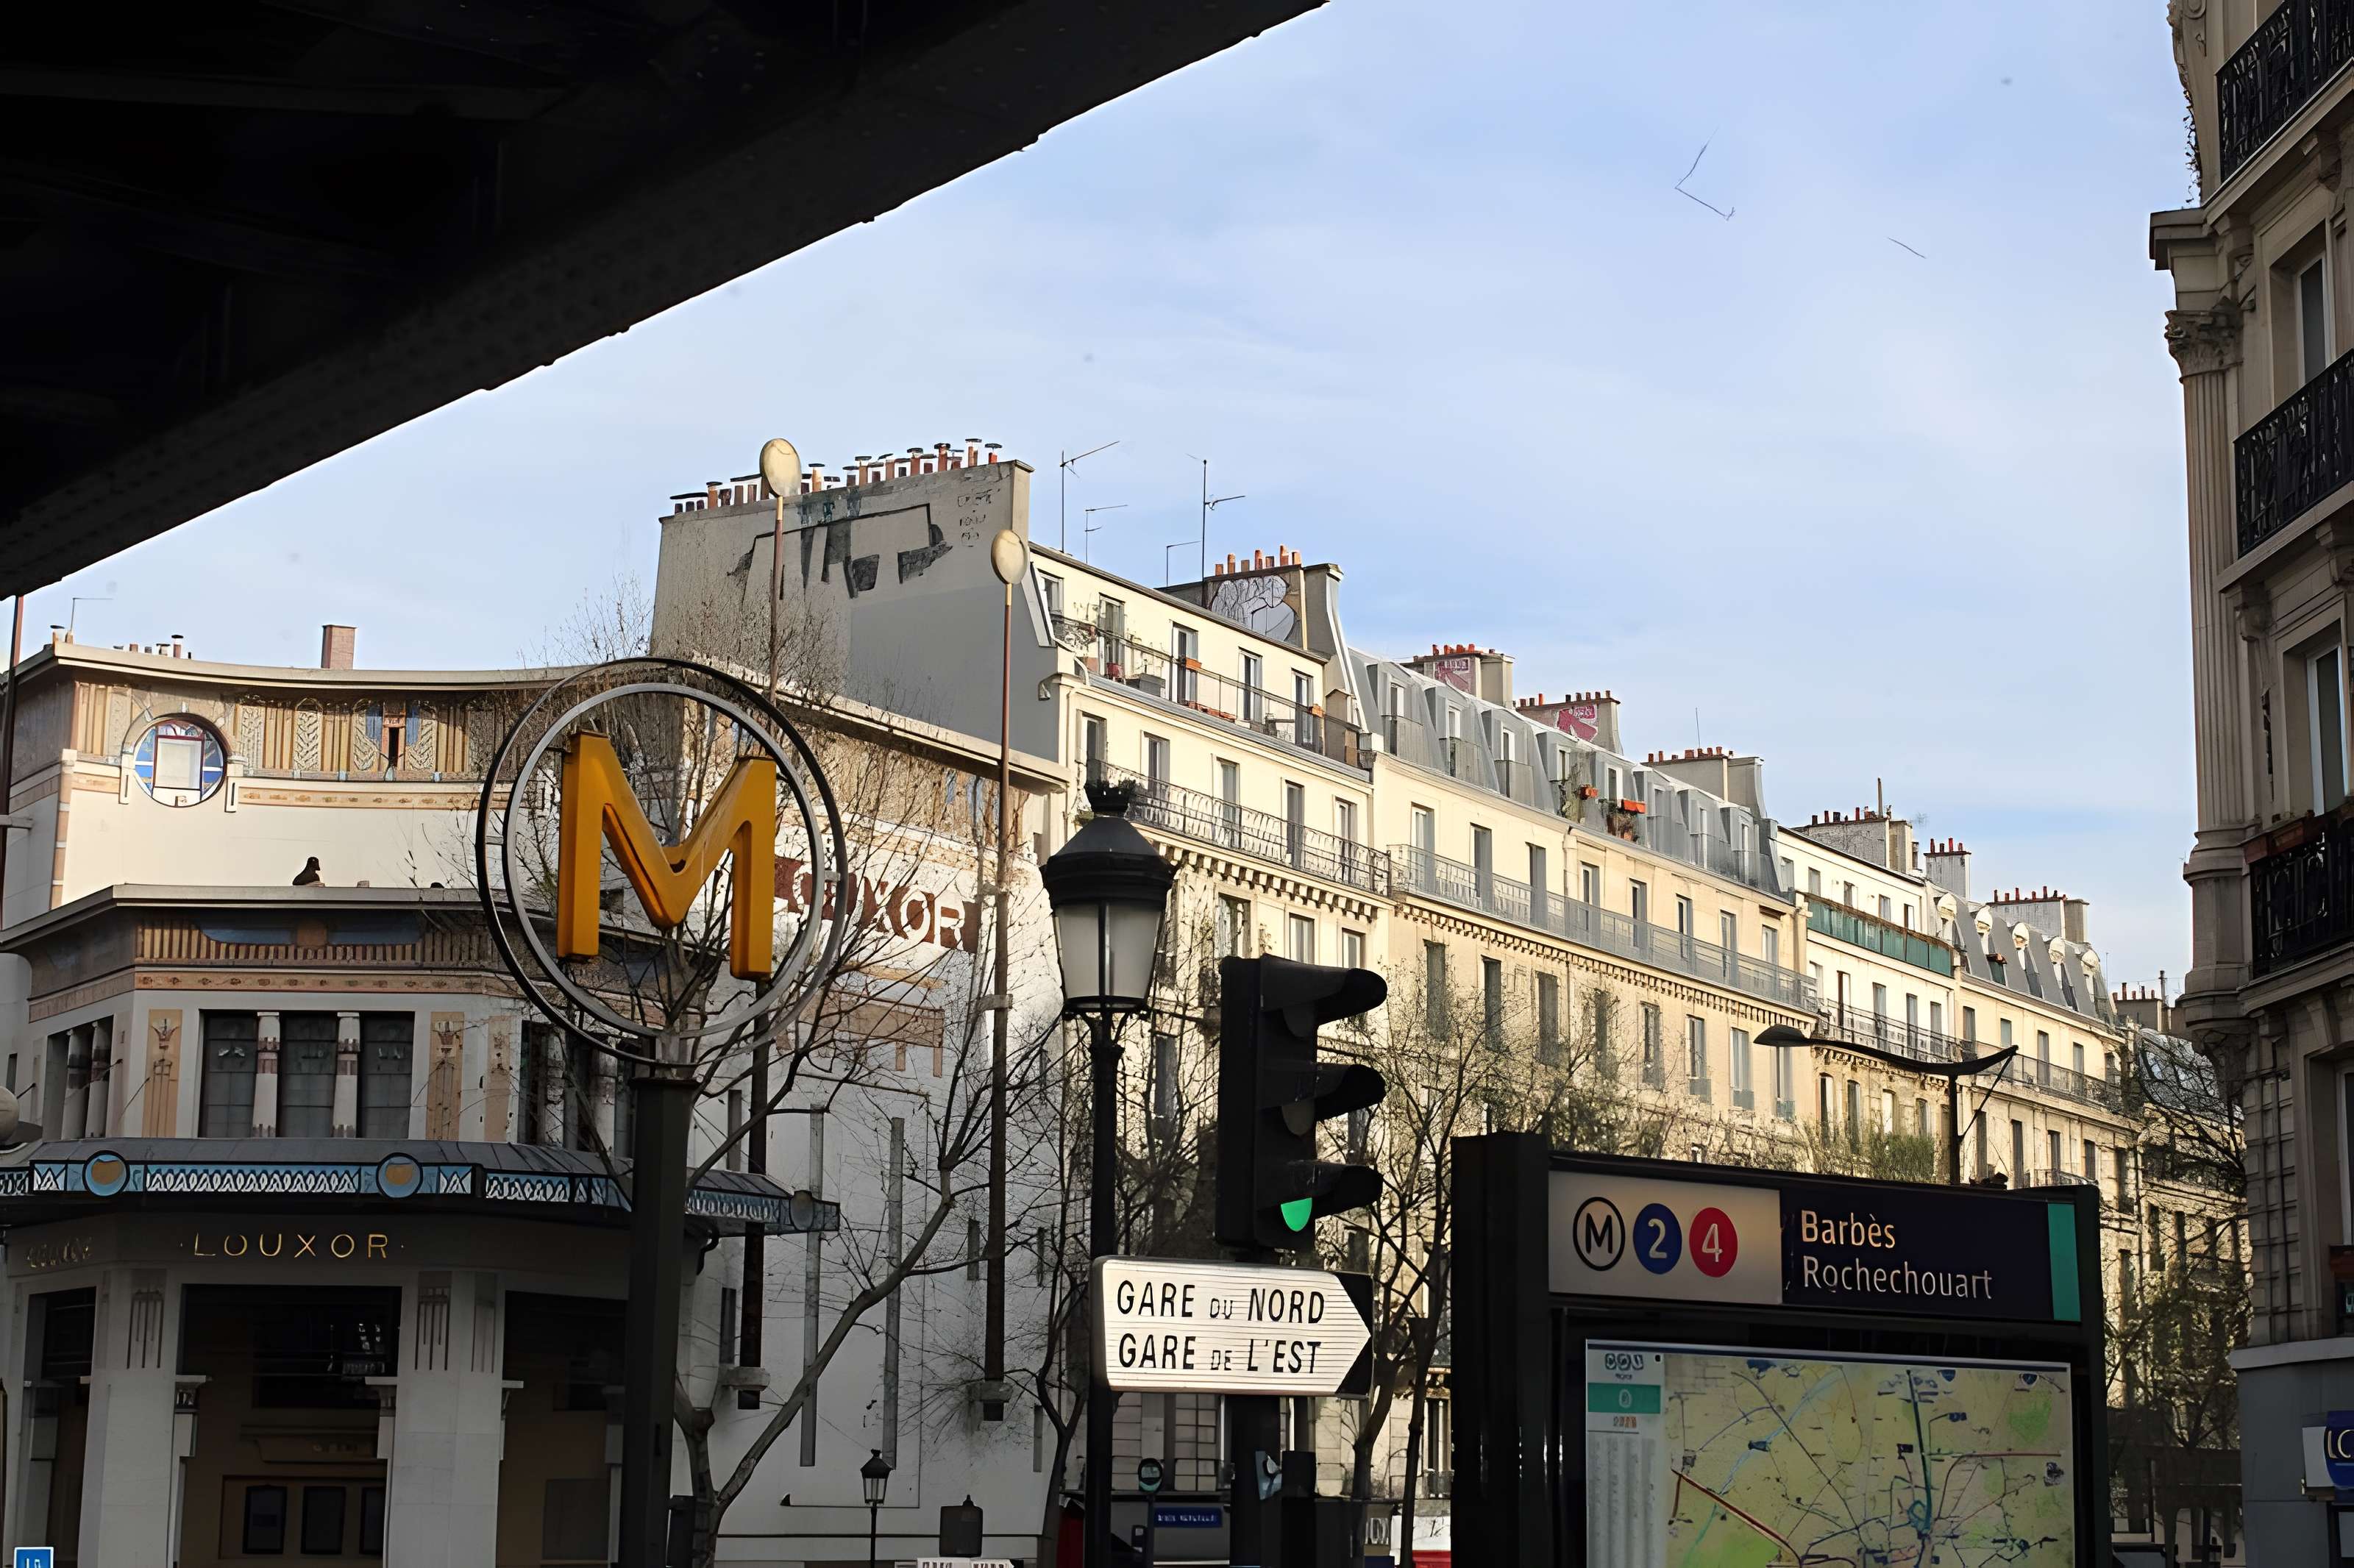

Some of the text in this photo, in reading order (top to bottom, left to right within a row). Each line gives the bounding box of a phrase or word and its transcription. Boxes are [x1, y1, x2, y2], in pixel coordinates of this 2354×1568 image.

[558, 731, 777, 982] M
[193, 1233, 388, 1258] LOUXOR
[1585, 1212, 1724, 1263] M 2 4
[1802, 1210, 1896, 1249] Barbès
[1803, 1255, 1993, 1300] Rochechouart
[1117, 1280, 1325, 1324] GARE DU NORD
[1119, 1333, 1322, 1374] GARE DE L'EST
